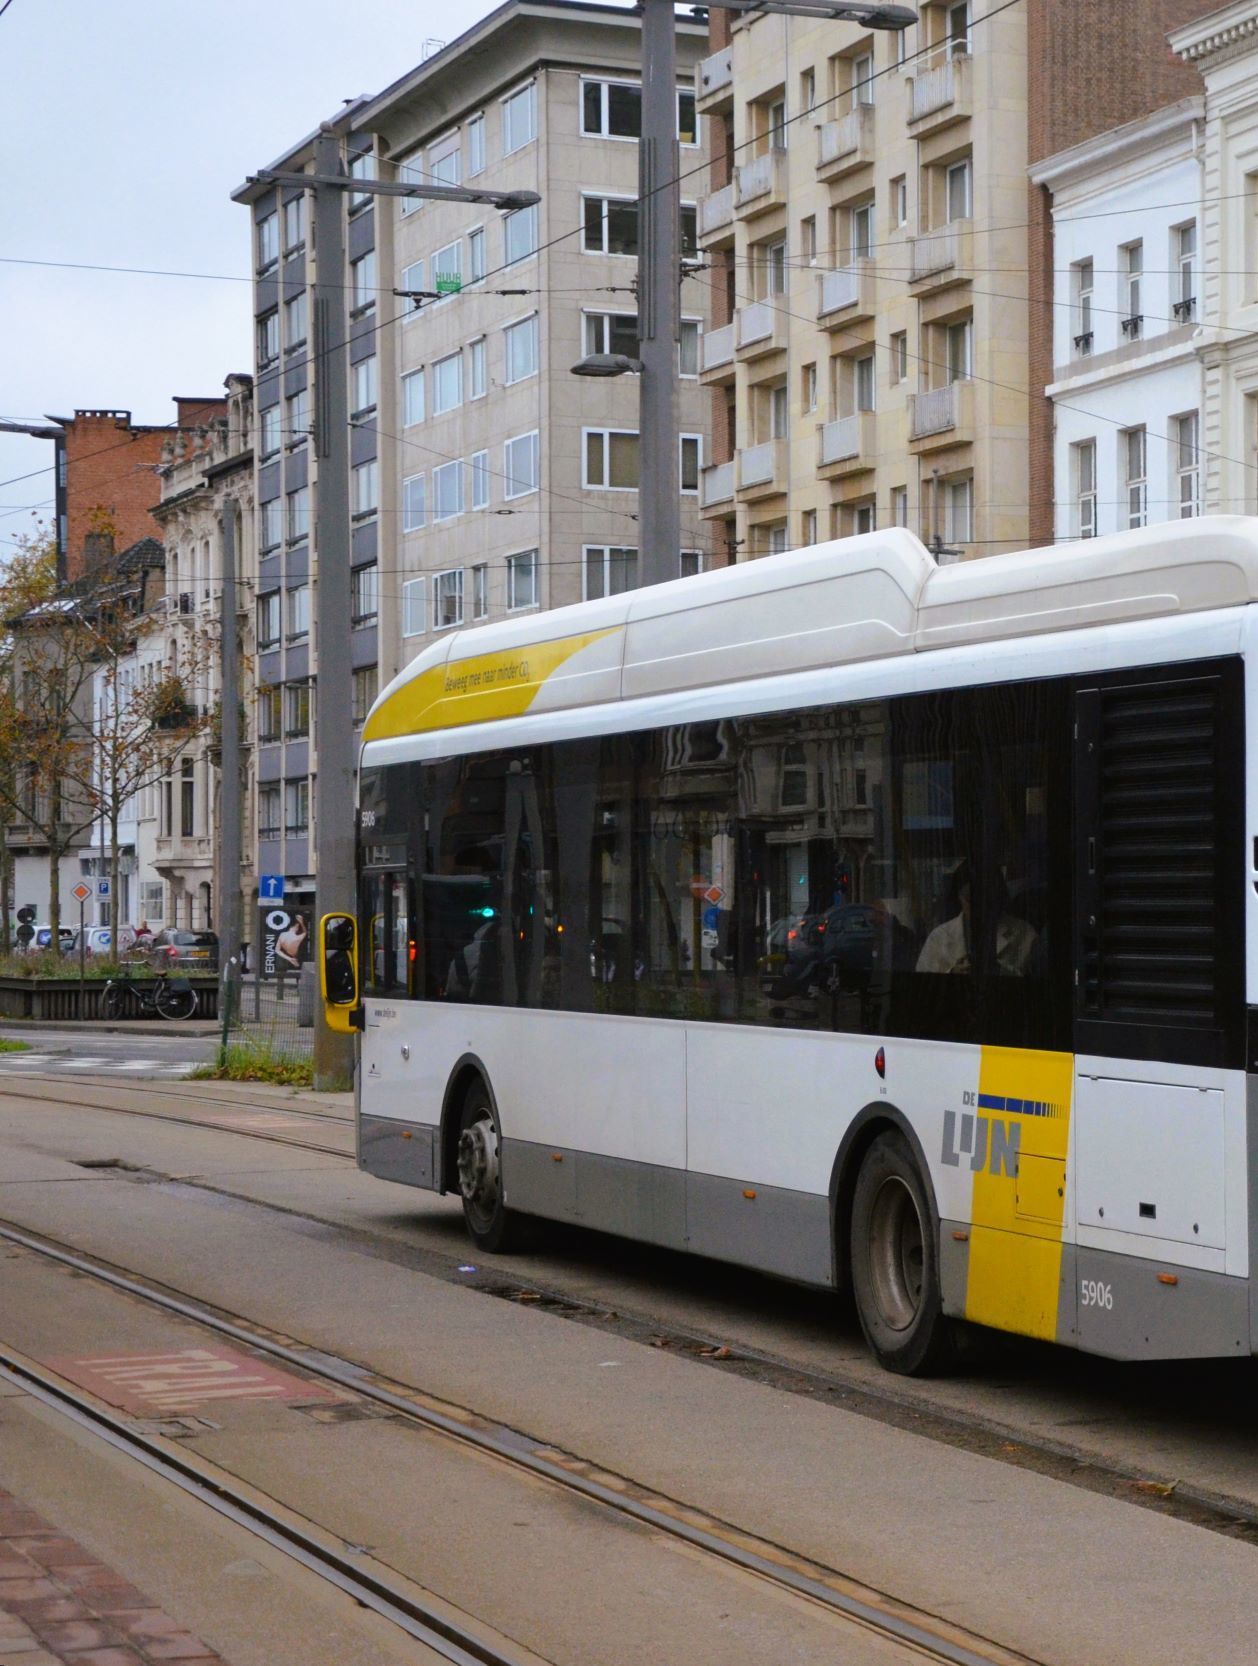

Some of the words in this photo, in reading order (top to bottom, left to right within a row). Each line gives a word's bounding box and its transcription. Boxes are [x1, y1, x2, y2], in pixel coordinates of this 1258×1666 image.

[265, 934, 276, 973] ERNANI
[962, 1090, 976, 1107] DE
[941, 1110, 1022, 1179] LIJN
[1081, 1279, 1113, 1310] 5906
